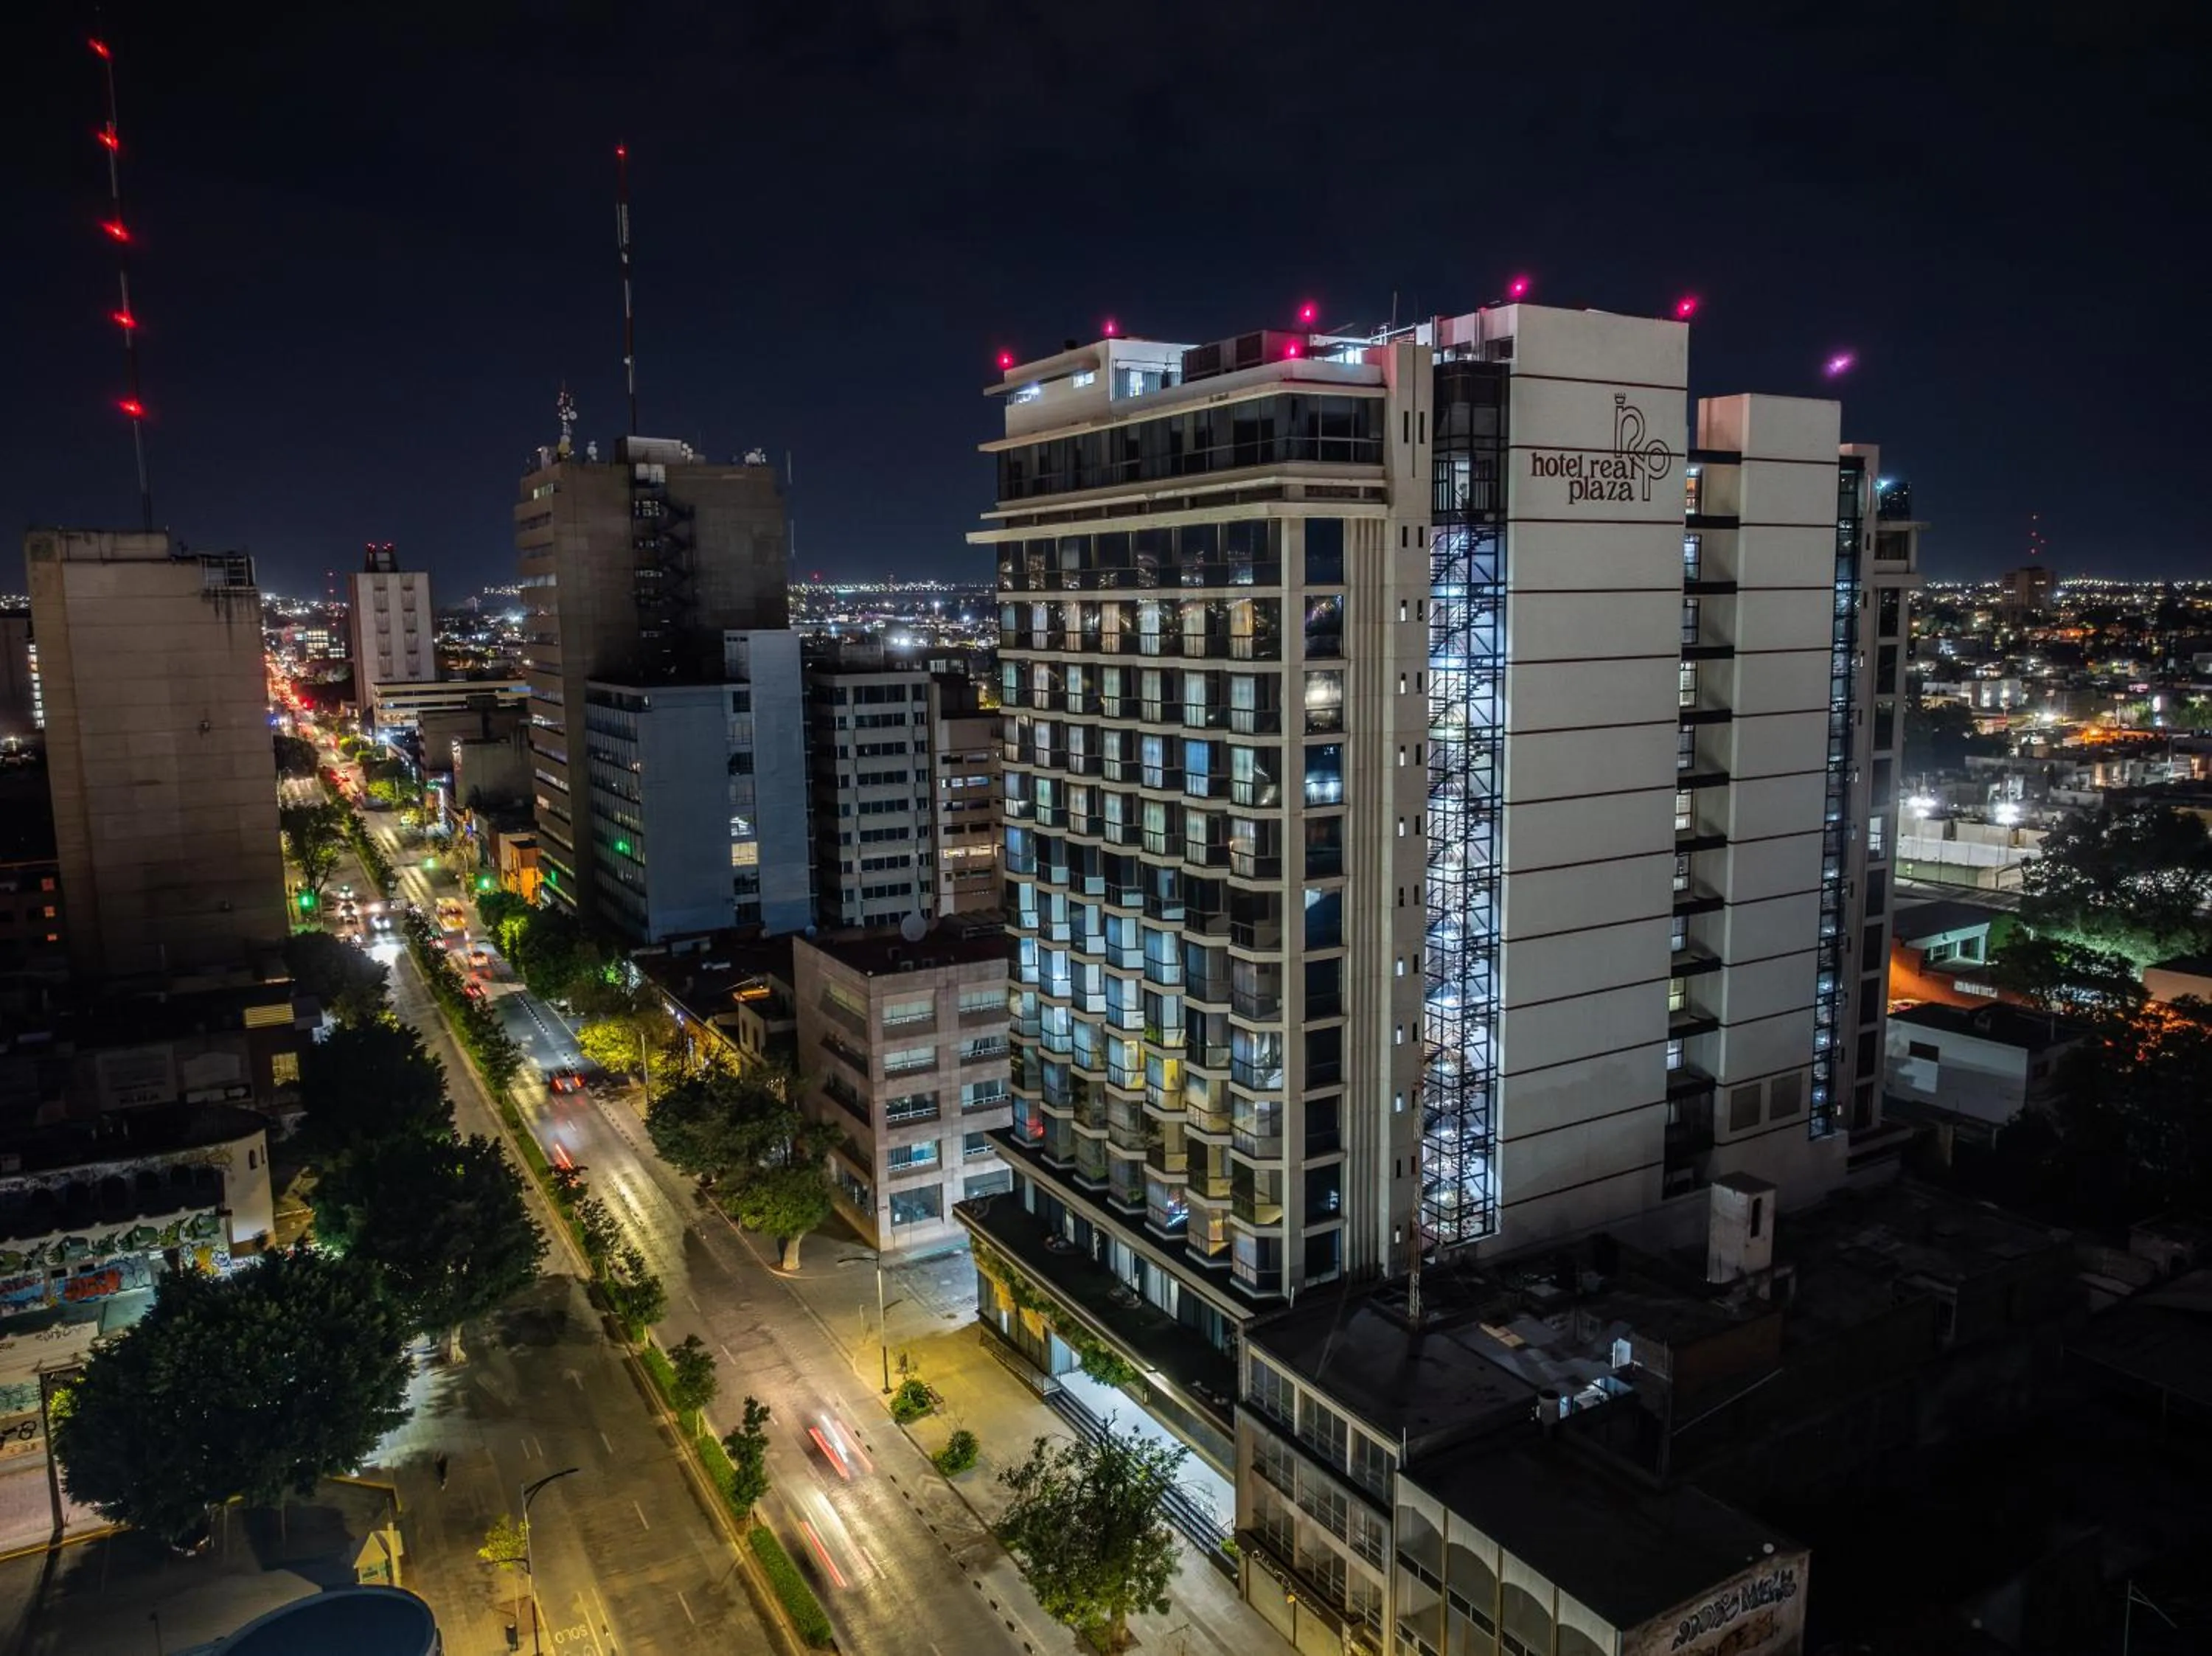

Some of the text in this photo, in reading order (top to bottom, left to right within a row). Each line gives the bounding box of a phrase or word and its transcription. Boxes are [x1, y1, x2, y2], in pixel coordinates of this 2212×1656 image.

[1531, 452, 1636, 479] hotel real
[1568, 476, 1635, 504] plaza
[555, 1624, 588, 1643] SOLO
